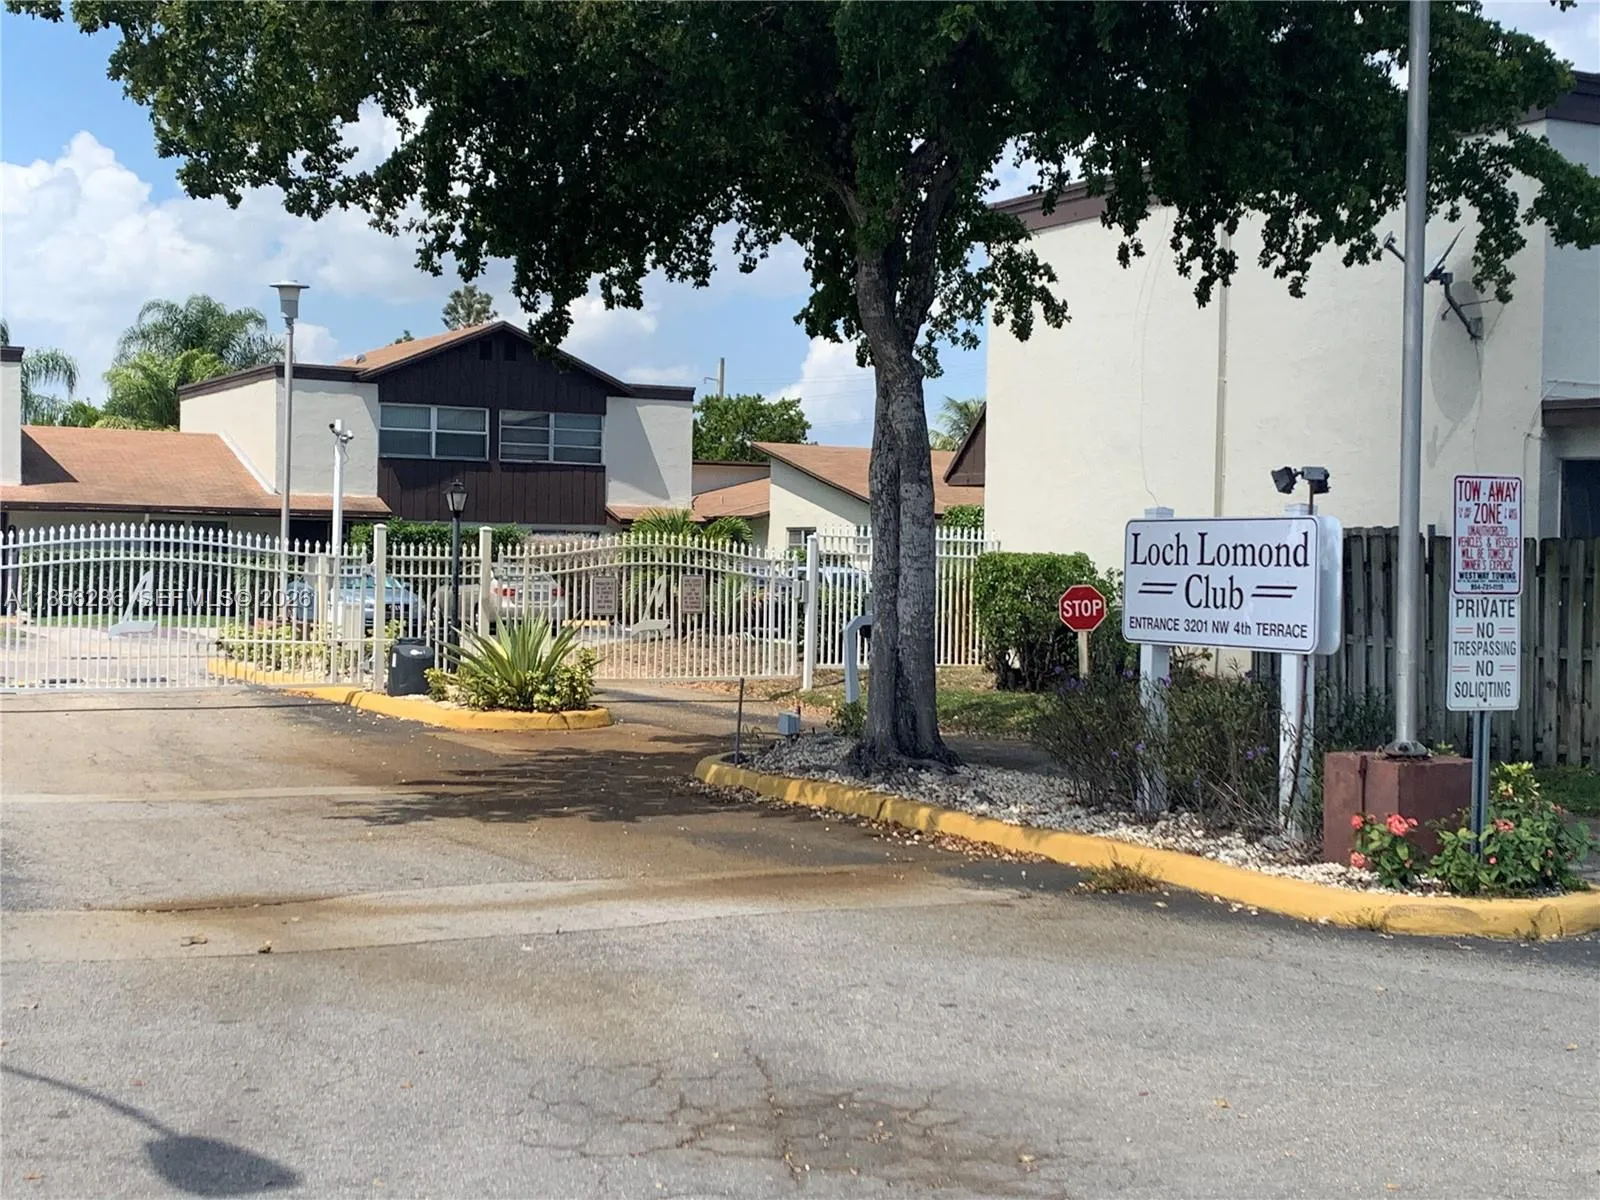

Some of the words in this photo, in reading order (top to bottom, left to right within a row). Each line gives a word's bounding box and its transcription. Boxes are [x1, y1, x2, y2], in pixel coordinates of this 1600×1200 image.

[1458, 480, 1481, 501] TOW
[1488, 480, 1518, 501] AWAY
[1474, 503, 1502, 524] ZONE
[1130, 532, 1190, 567] Loch
[1196, 531, 1310, 568] Lomond
[1184, 573, 1245, 611] Club
[1063, 599, 1102, 617] STOP
[1456, 599, 1515, 618] PRIVATE
[1129, 616, 1180, 632] ENTRANCE
[1184, 619, 1208, 633] 3201
[1212, 621, 1230, 634] NW
[1233, 622, 1252, 636] 4th
[1256, 622, 1308, 639] TERRACE
[1476, 622, 1494, 638] NO
[1453, 640, 1517, 656] TRESPASSING
[1475, 660, 1494, 677] NO
[1454, 681, 1511, 698] SOLICITING
